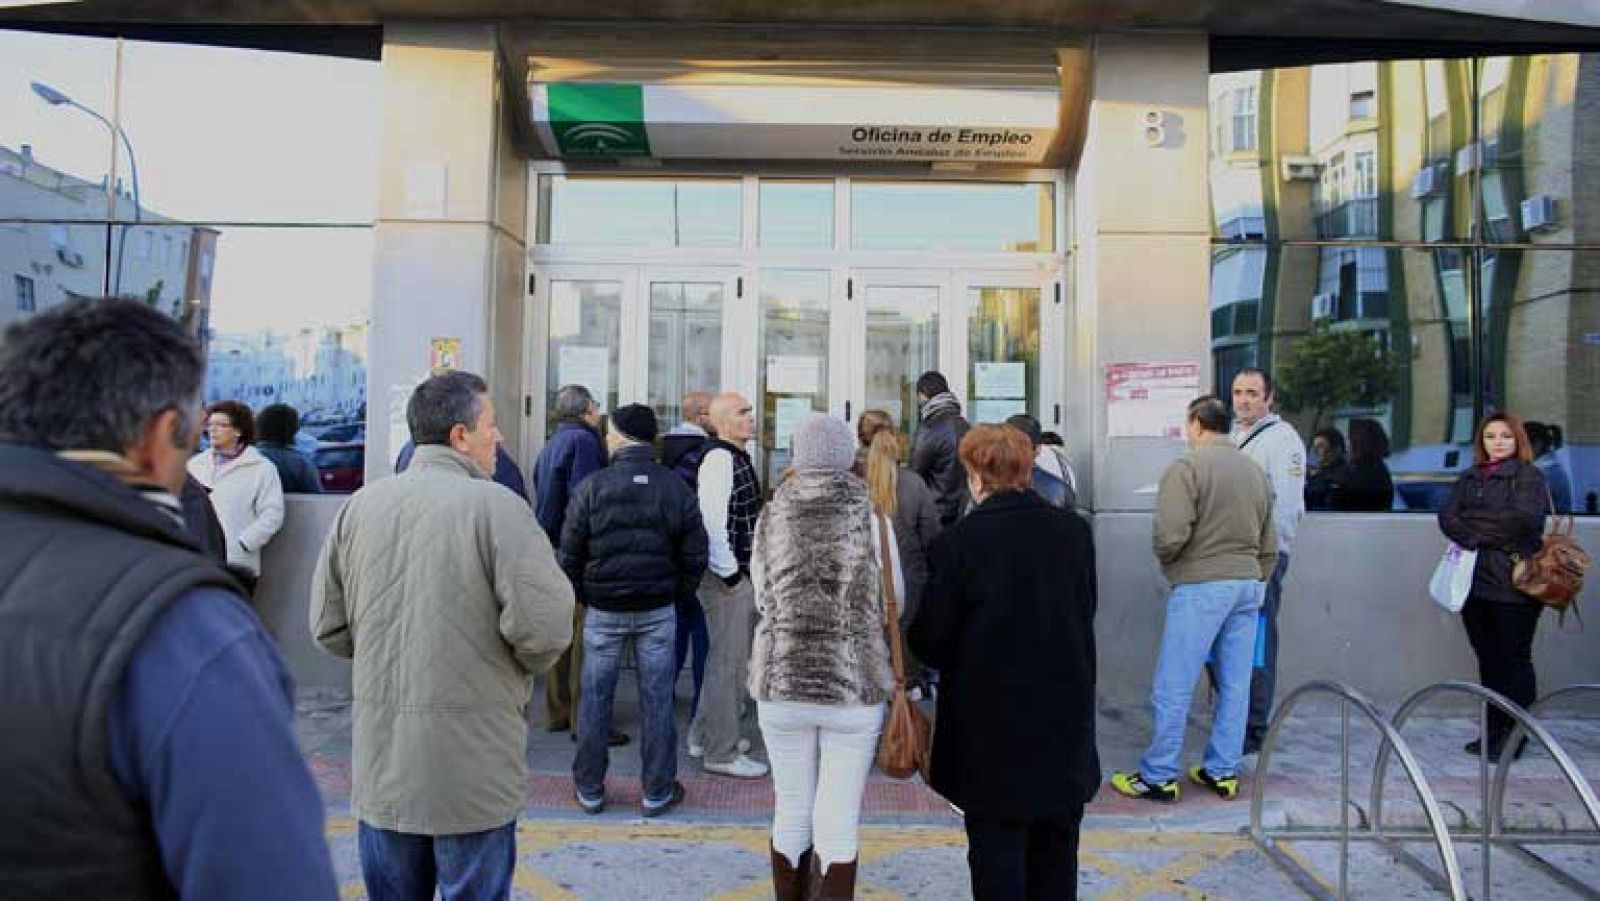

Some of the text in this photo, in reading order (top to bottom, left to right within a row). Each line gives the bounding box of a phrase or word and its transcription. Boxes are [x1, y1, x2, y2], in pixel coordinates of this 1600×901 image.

[851, 126, 1033, 147] Oficina de Empleo
